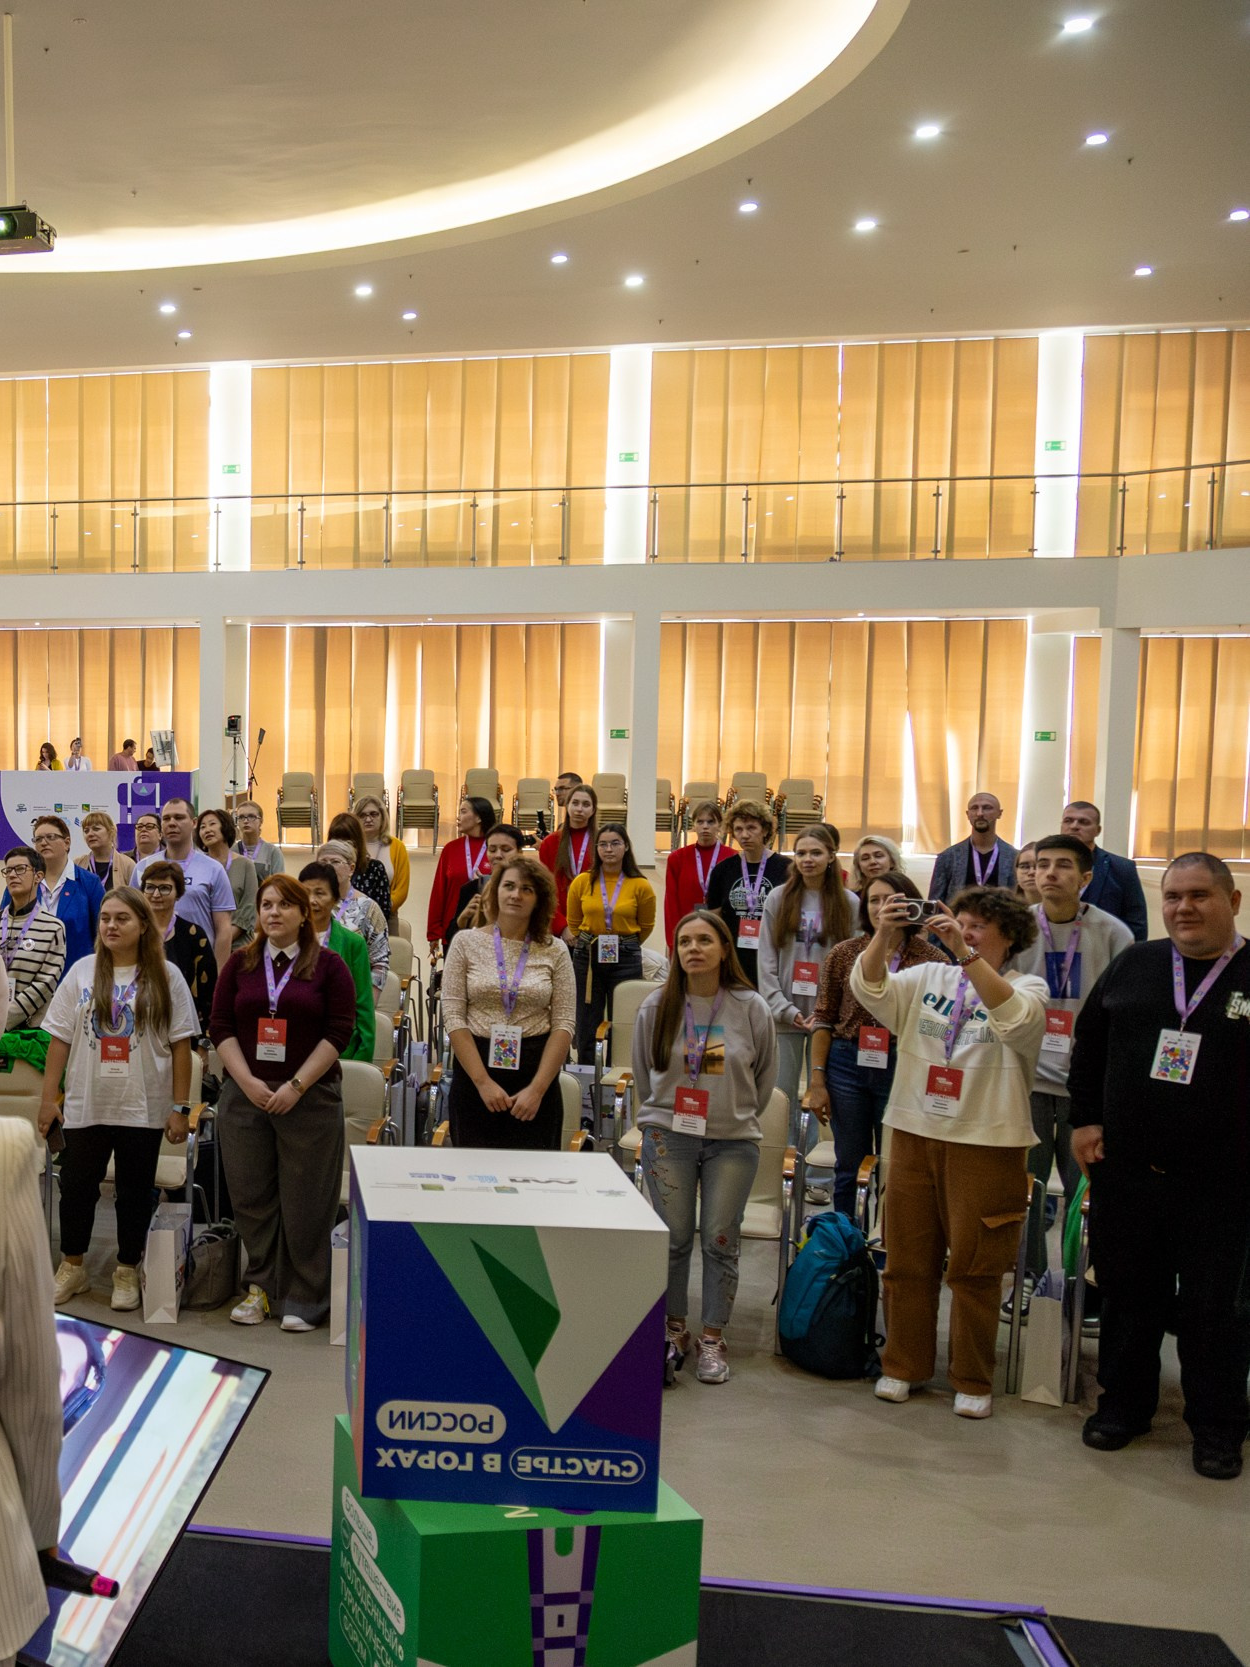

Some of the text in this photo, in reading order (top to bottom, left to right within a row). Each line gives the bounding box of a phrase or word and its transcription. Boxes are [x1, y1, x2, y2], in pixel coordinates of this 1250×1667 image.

[388, 1409, 495, 1434] РОССИИ
[375, 1447, 639, 1478] СЧАСТЬЕ В ГОРАХ
[352, 1543, 402, 1623] путешествие
